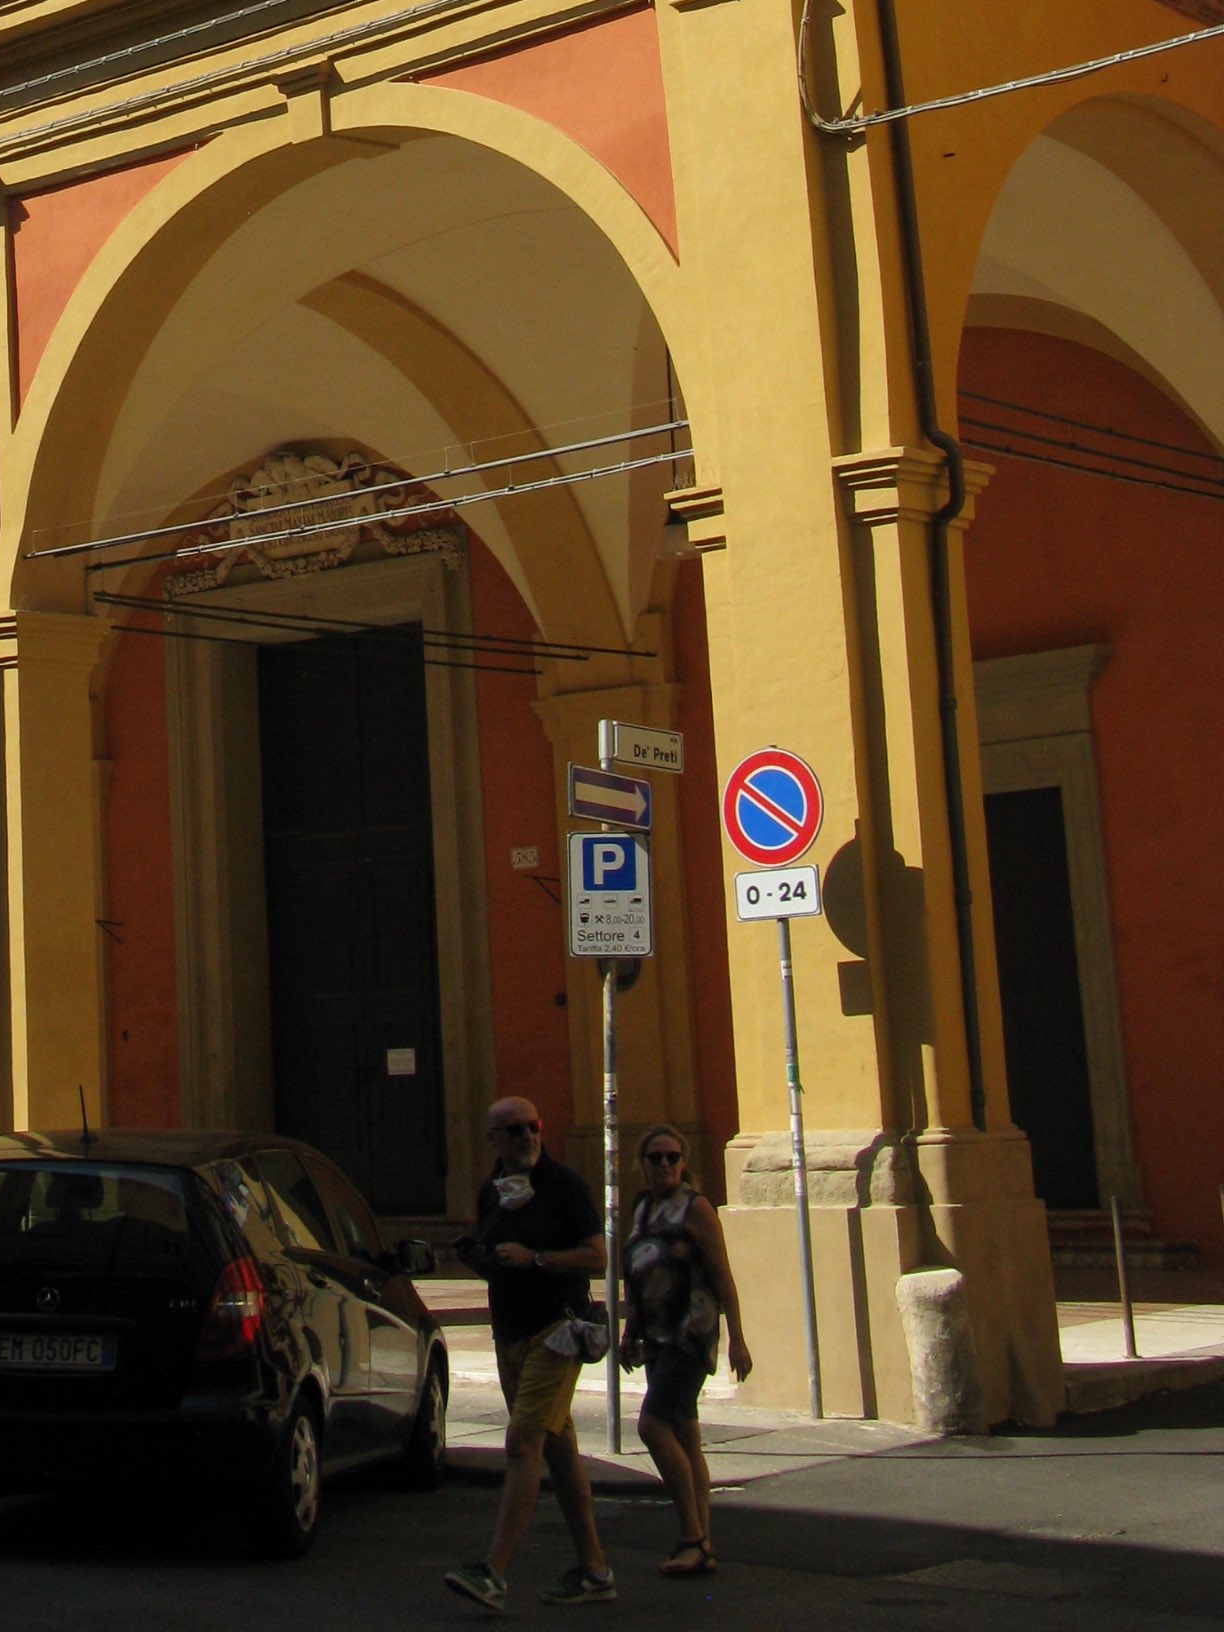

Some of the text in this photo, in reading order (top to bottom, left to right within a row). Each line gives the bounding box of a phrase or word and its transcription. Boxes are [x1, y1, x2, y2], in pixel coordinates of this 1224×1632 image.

[653, 747, 678, 764] Preti
[593, 843, 625, 885] P
[746, 885, 760, 905] 0
[778, 880, 807, 902] 24
[577, 929, 641, 942] Settore 4
[577, 944, 602, 953] Tariffa
[624, 944, 646, 953] €/ora
[32, 1338, 99, 1363] 050FC
